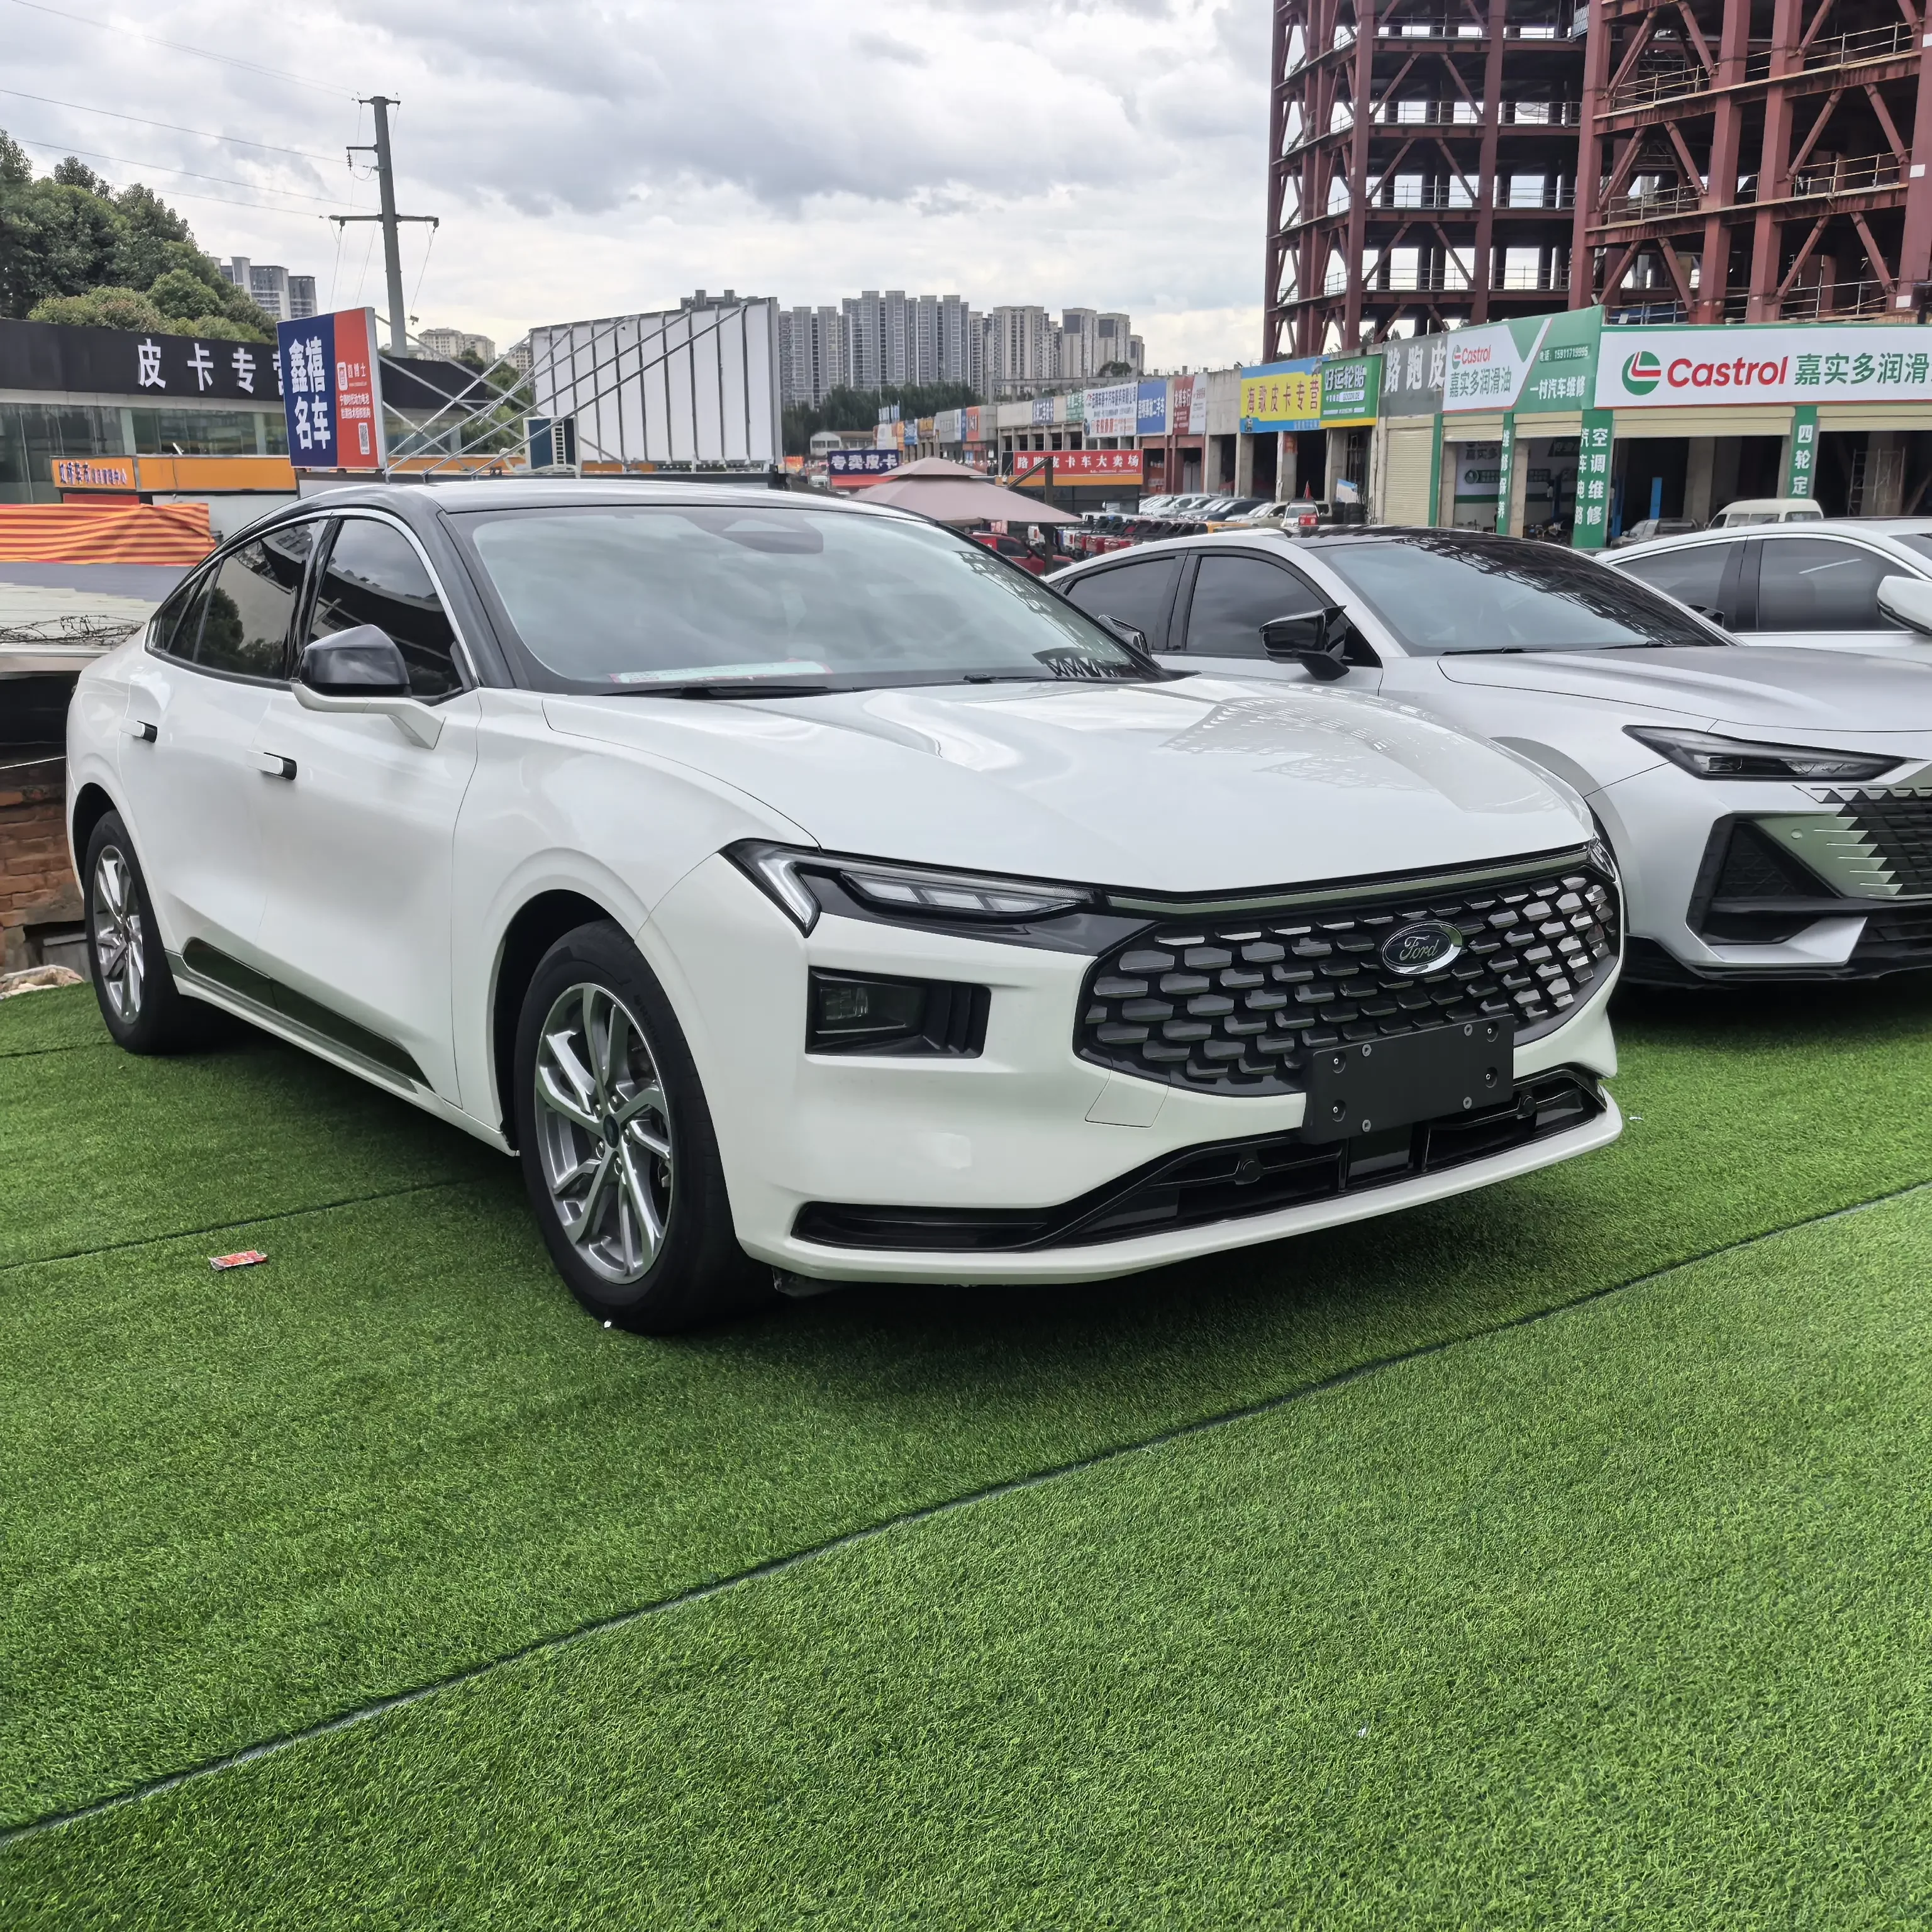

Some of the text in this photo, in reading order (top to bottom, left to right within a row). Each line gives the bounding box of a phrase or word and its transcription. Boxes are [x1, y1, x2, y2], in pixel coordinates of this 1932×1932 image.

[138, 338, 283, 395] 皮卡专
[289, 336, 326, 394] 鑫禧
[1324, 365, 1367, 391] 好运轮胎
[1449, 366, 1512, 397] 嘉实多润滑油
[1462, 345, 1492, 365] Castrol
[1667, 353, 1932, 387] Castrol 嘉实多润滑
[294, 395, 331, 449] 名车
[1497, 430, 1510, 519] 维修保养
[1587, 428, 1608, 525] 空调维修
[1792, 425, 1813, 495] 四轮定
[1399, 935, 1439, 961] Ford
